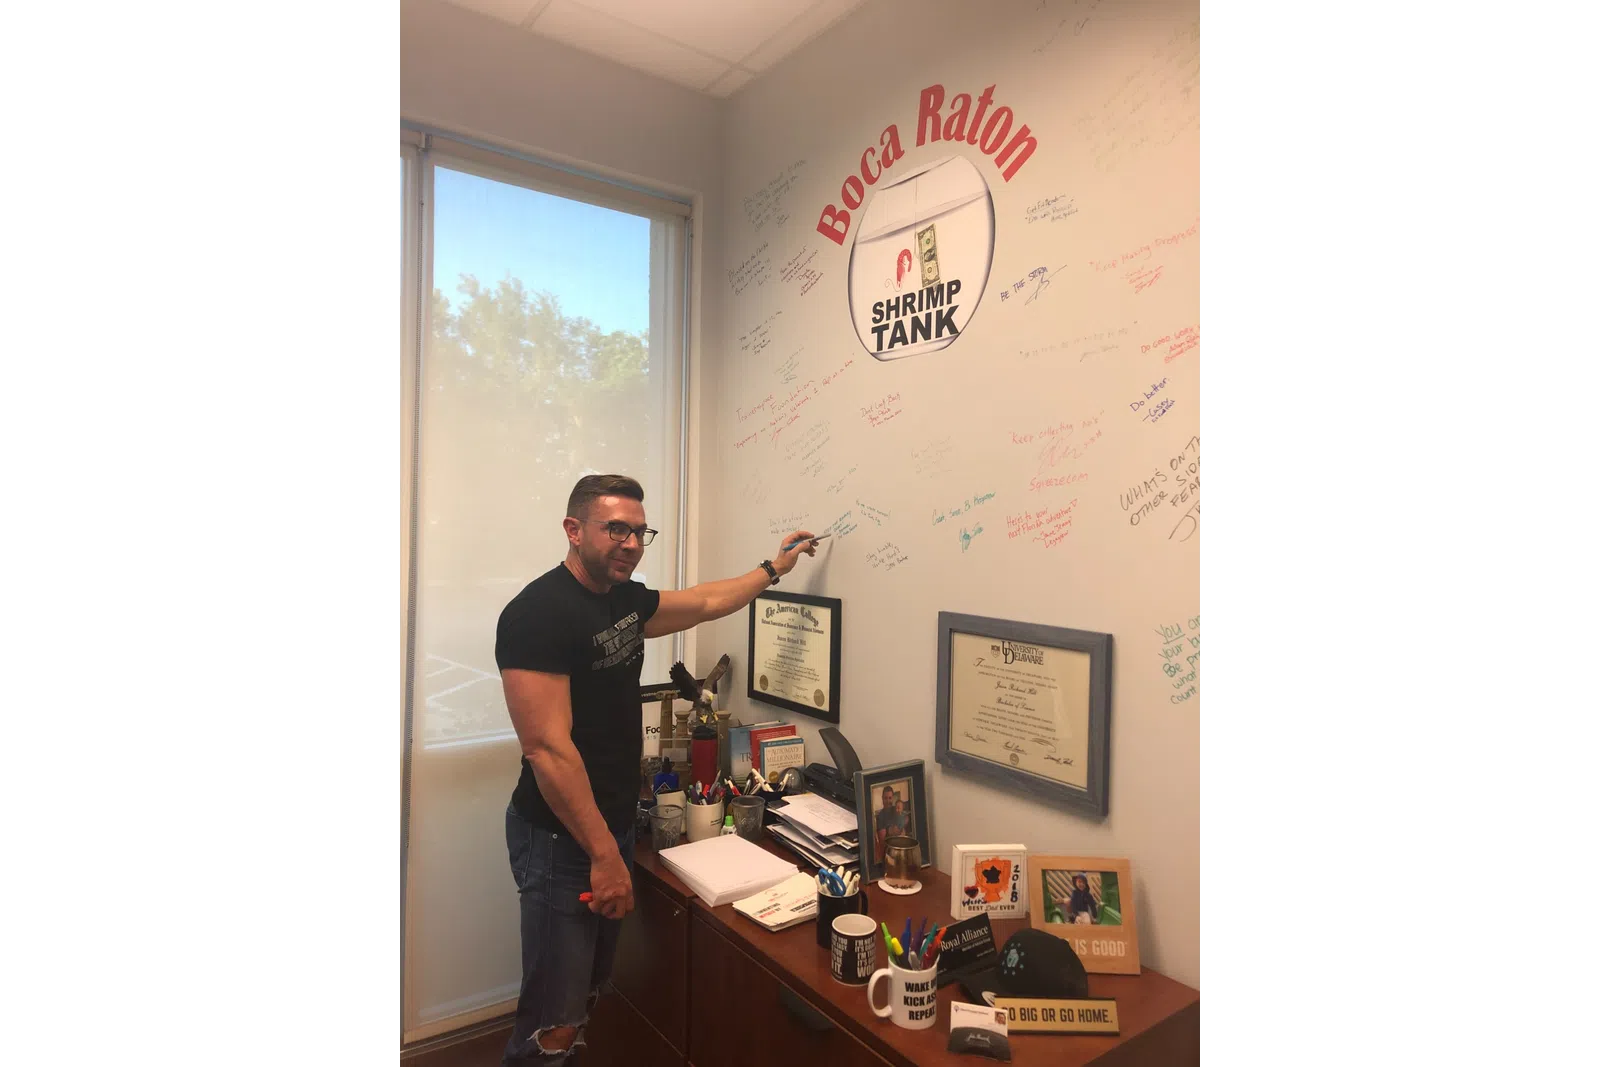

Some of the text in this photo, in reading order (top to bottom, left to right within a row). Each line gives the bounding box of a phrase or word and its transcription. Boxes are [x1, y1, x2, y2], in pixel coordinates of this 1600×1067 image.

[816, 124, 904, 245] Boca
[916, 84, 1038, 183] Raton
[1012, 280, 1025, 292] THE
[872, 279, 962, 324] SHRIMP
[871, 305, 960, 352] TANK
[1130, 400, 1144, 412] Do
[1120, 468, 1168, 511] WHAT'S
[1170, 452, 1185, 471] ON
[1025, 510, 1032, 521] to
[1130, 491, 1168, 526] OTHER
[766, 603, 819, 627] The American College
[1154, 623, 1183, 644] You
[1002, 641, 1039, 656] UNIVERSITY
[1004, 648, 1044, 665] DELAWARE
[940, 926, 988, 952] Royal Alliance
[1075, 939, 1126, 956] IS GOOD
[905, 981, 929, 992] WAKE
[904, 996, 925, 1007] KICK
[908, 1006, 935, 1020] REPEAT
[1020, 1007, 1038, 1022] BIG
[1042, 1008, 1056, 1022] OR
[1060, 1008, 1074, 1022] GO
[1078, 1009, 1113, 1024] HOME.
